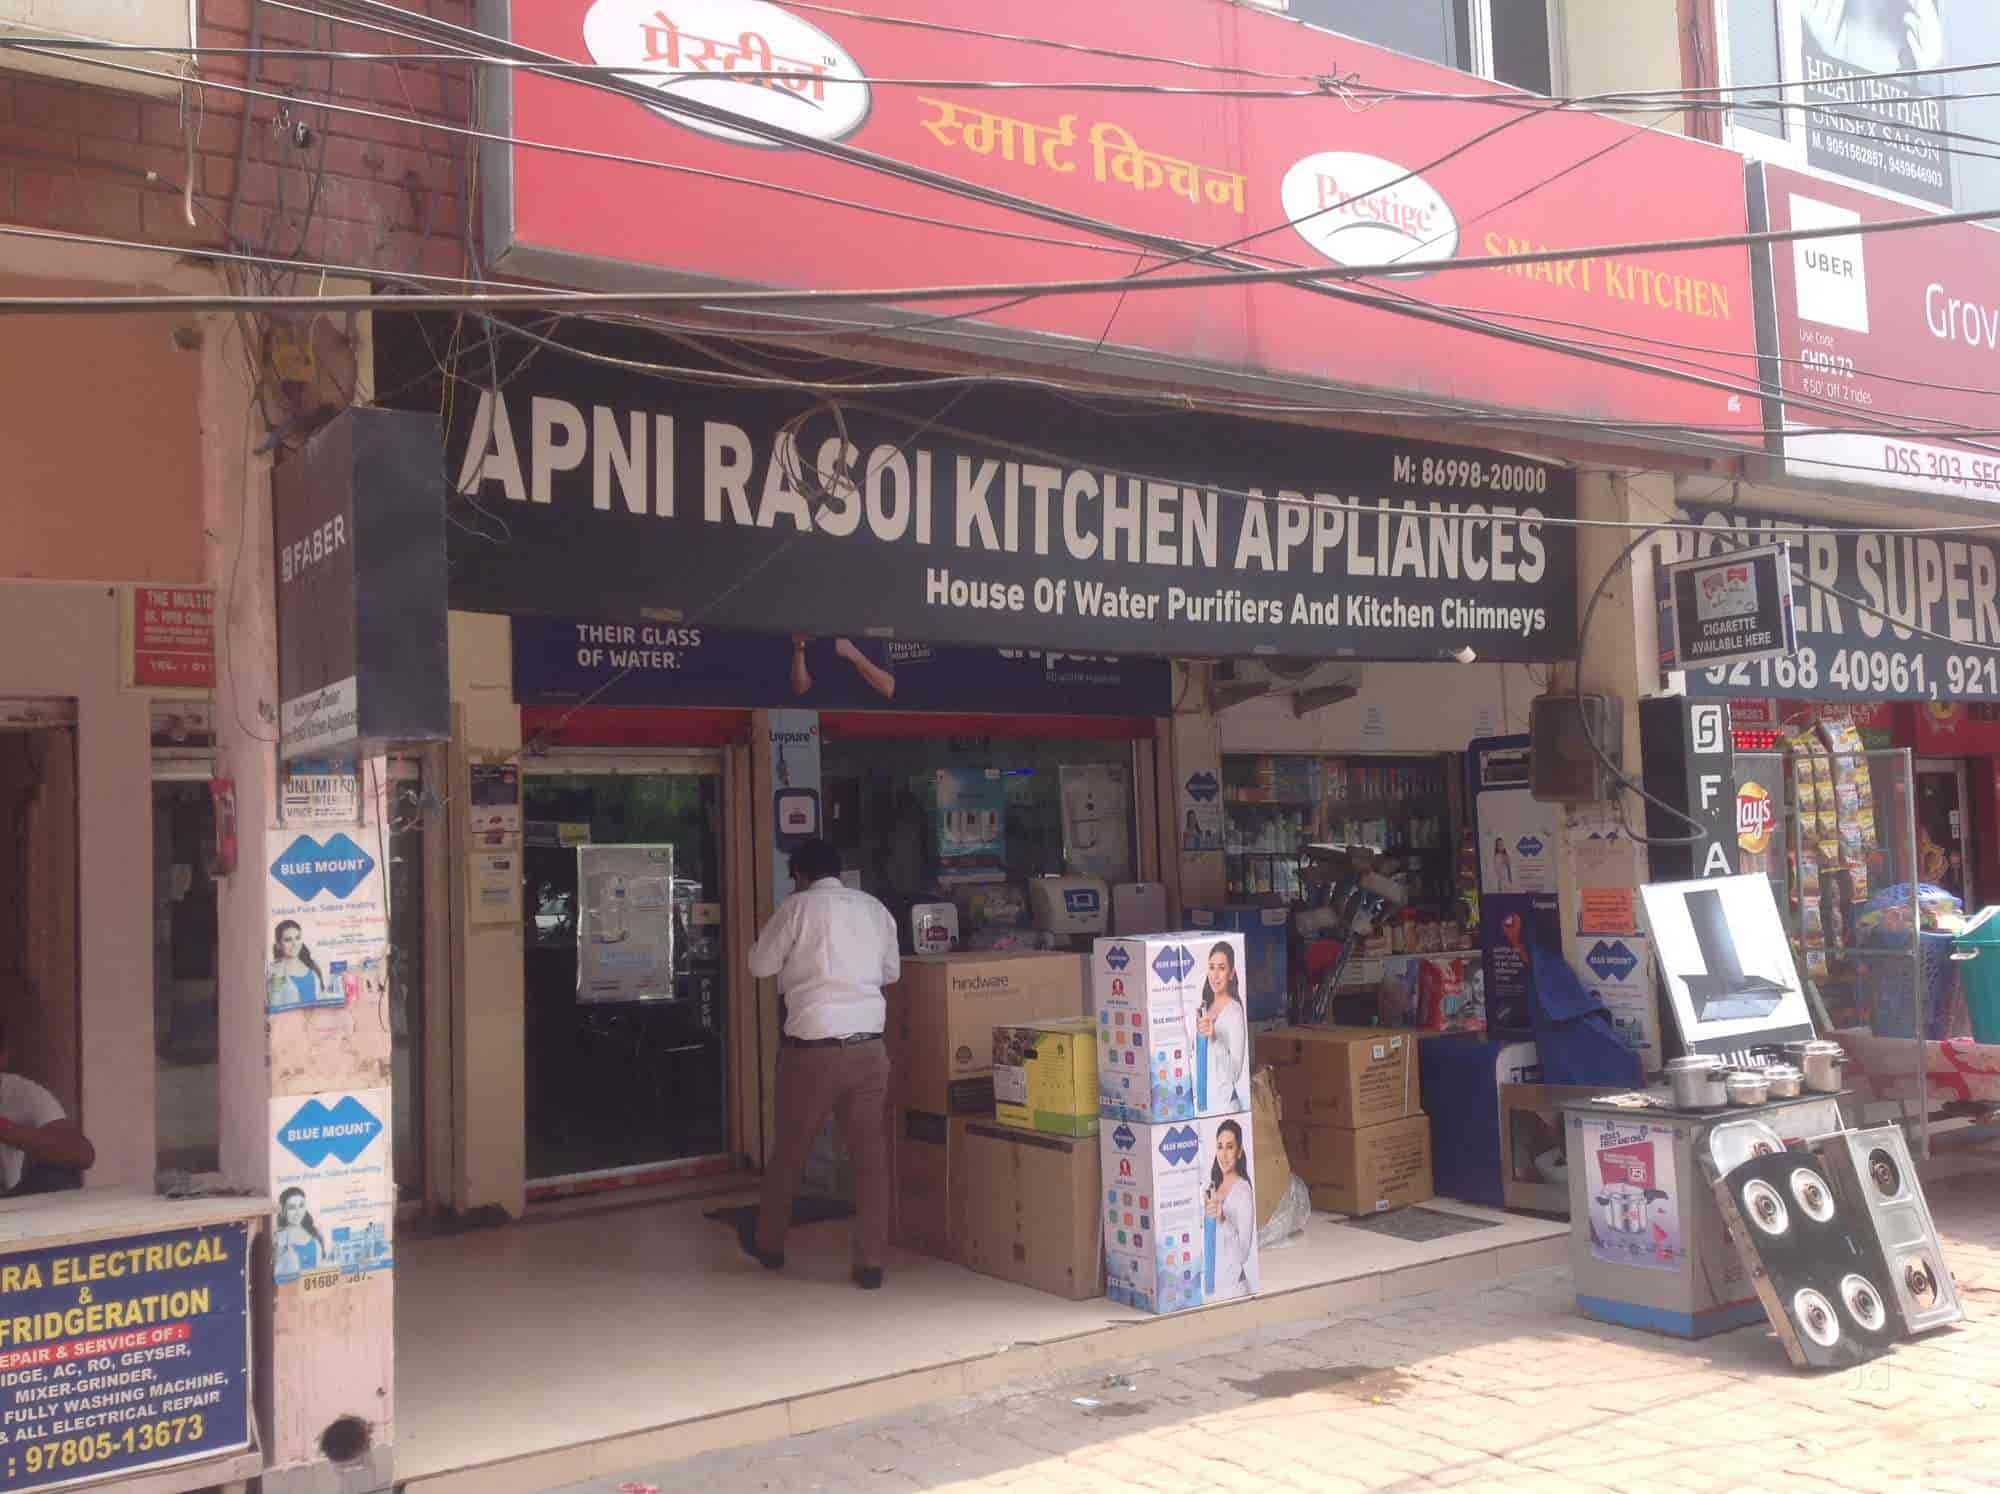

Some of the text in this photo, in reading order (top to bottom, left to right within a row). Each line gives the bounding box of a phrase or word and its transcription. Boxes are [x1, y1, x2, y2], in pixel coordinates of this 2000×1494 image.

[917, 96, 1248, 215] स्मार्ट किचन
[1315, 172, 1432, 234] Prestige
[1484, 231, 1731, 321] SMART KITCHEN
[1804, 250, 1854, 278] UBER
[455, 389, 1546, 584] APNI RASOI KITCHEN APPLIANCES
[1421, 461, 1547, 495] 86998-20000
[292, 513, 346, 573] FABER
[926, 567, 1547, 638] House Of Water Purifiers And Kitchen Chimneys
[1856, 531, 2000, 644] SUPER
[576, 624, 701, 646] THEIR GLASS
[1688, 631, 1772, 656] AVAILABLE HERE
[1703, 616, 1758, 636] CIGARETTE
[577, 647, 604, 667] OF
[1829, 649, 1938, 700] 40961,
[1946, 655, 2000, 694] 921
[1736, 791, 1771, 840] Lay's
[281, 858, 365, 876] BLUE MOUNT
[953, 975, 1009, 992] hindware
[287, 1121, 372, 1143] BLUE MOUNT
[1, 1236, 229, 1293] RA ELECTRICAL
[78, 1286, 94, 1305] &
[53, 1362, 82, 1379] AC,
[88, 1356, 116, 1374] RO,
[121, 1343, 191, 1367] GEYSER,
[55, 1346, 69, 1359] &
[74, 1332, 147, 1356] SERVICE
[151, 1327, 173, 1342] OF
[4, 1371, 229, 1425] FULLY WASHING MACHINE,
[15, 1367, 158, 1404] MIXER-GRINDER,
[15, 1424, 50, 1442] ALL
[53, 1405, 159, 1435] ELECTRICAL
[162, 1390, 221, 1413] REPAIR
[25, 1413, 205, 1474] 97805-13673
